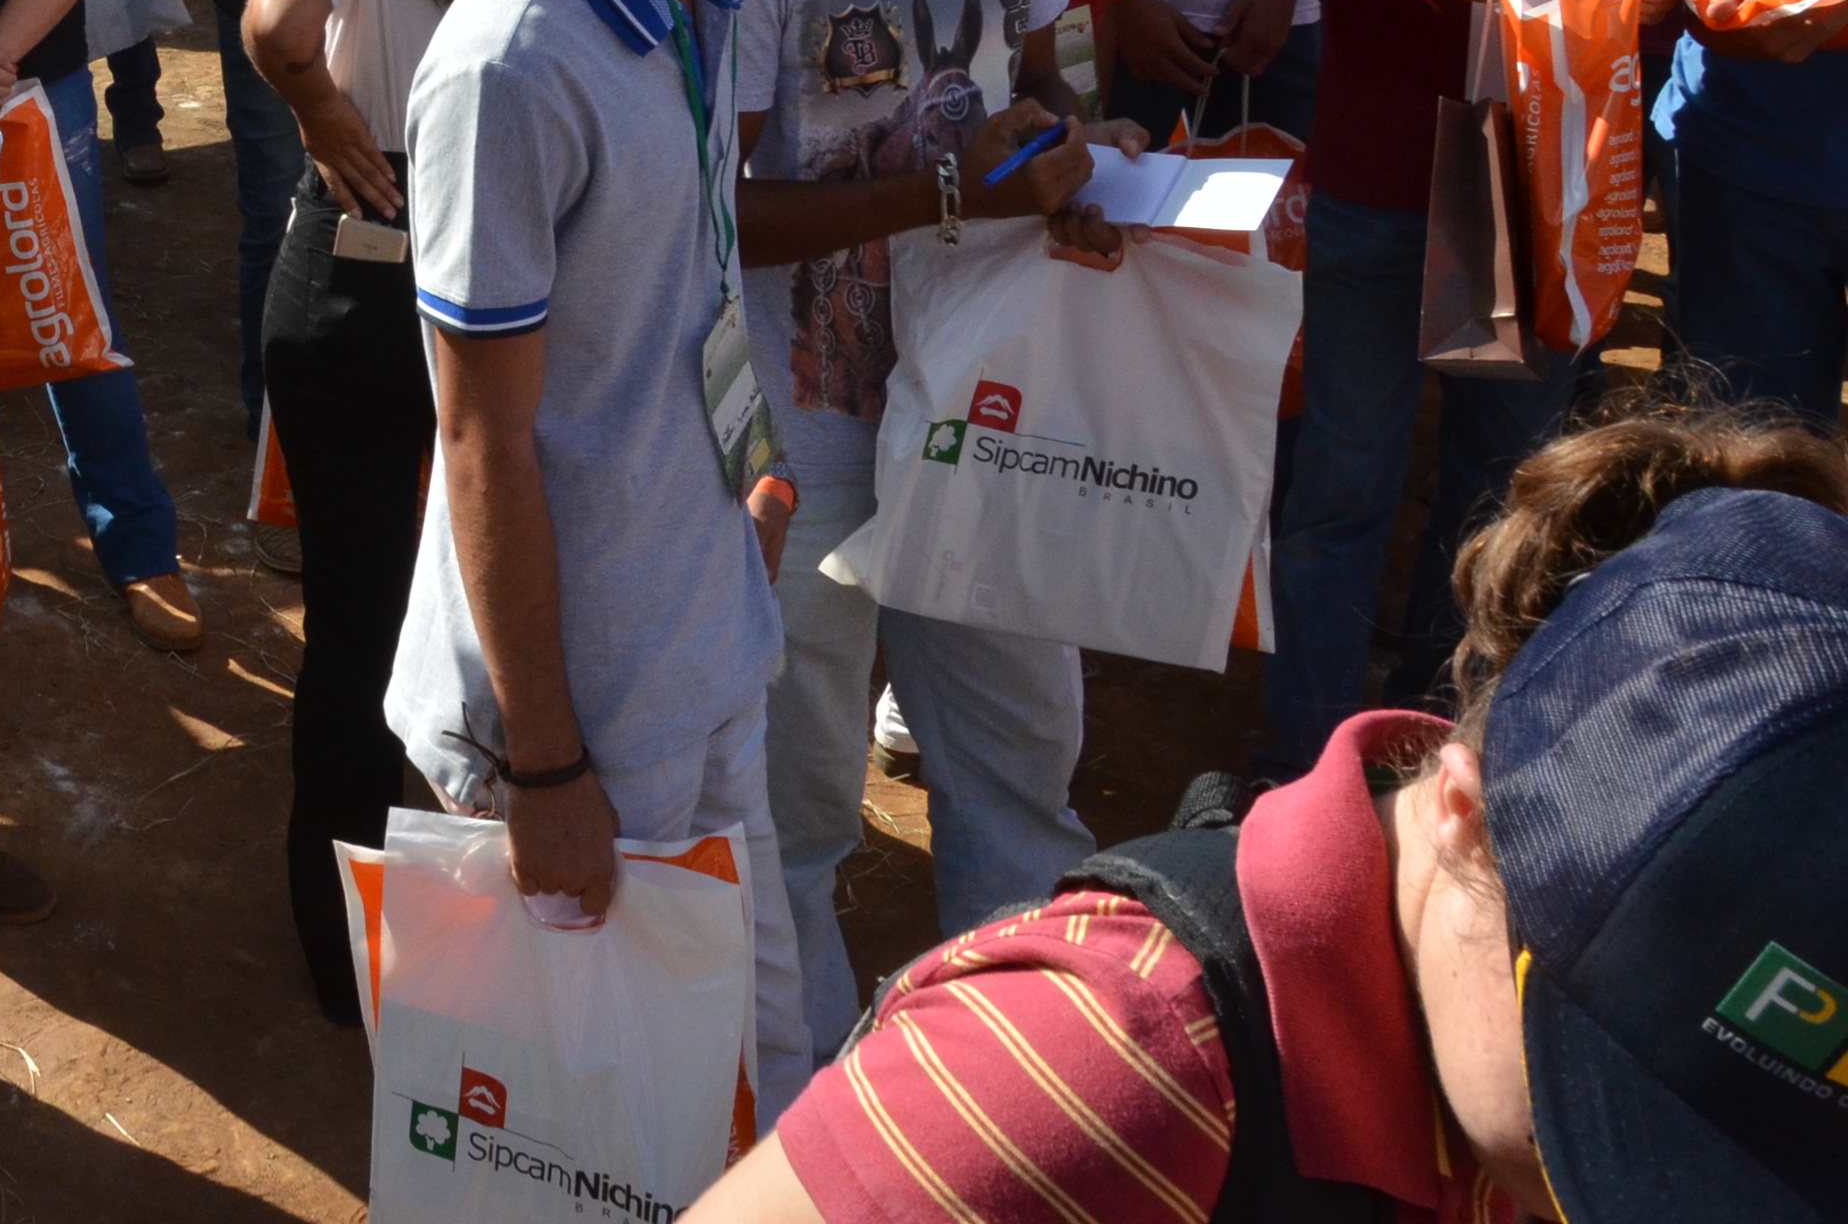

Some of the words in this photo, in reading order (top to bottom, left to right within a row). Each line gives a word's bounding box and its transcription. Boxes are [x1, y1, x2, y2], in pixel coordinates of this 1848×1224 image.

[46, 259, 65, 307] FILMES
[973, 436, 1198, 500] SipcamNichino
[1078, 486, 1192, 515] BRASIL
[1702, 1016, 1834, 1099] EVOLUINDO
